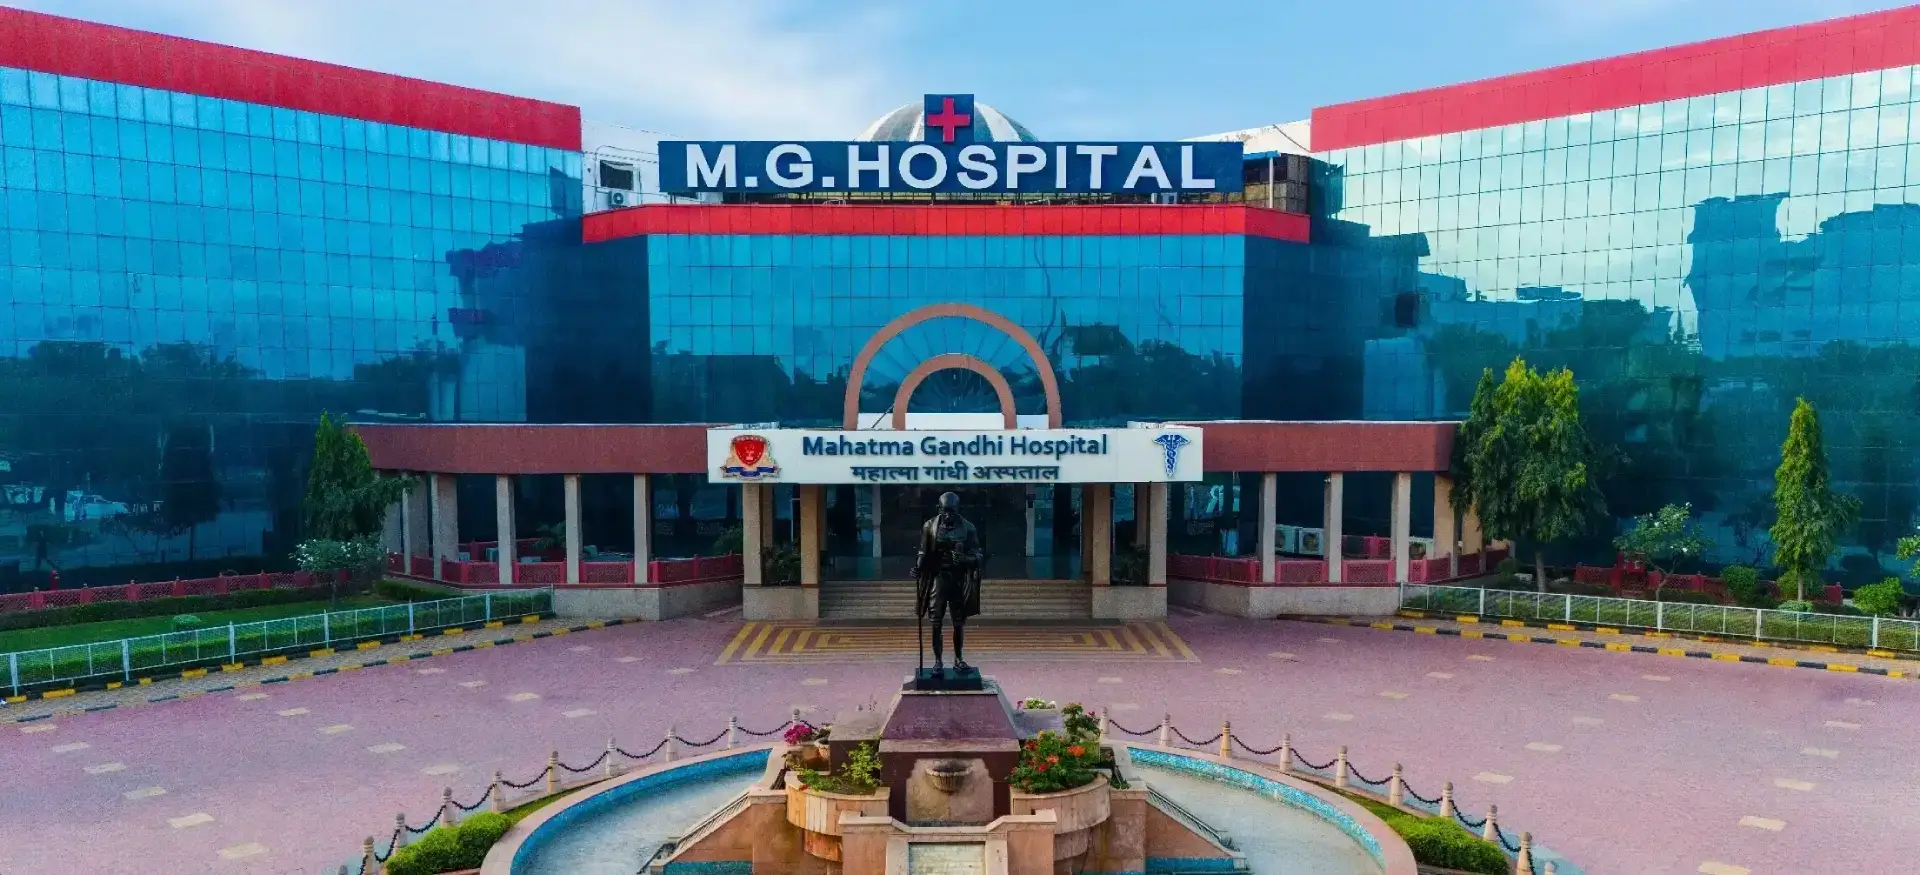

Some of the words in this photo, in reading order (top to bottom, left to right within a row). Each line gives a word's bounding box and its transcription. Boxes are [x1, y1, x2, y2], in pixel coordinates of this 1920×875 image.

[802, 434, 914, 456] Mahatma
[920, 433, 1004, 456] Gandhi
[1010, 433, 1107, 460] Hospital
[850, 465, 920, 482] महात्मा
[922, 460, 970, 481] गांधी
[973, 465, 1061, 481] अस्पताल
